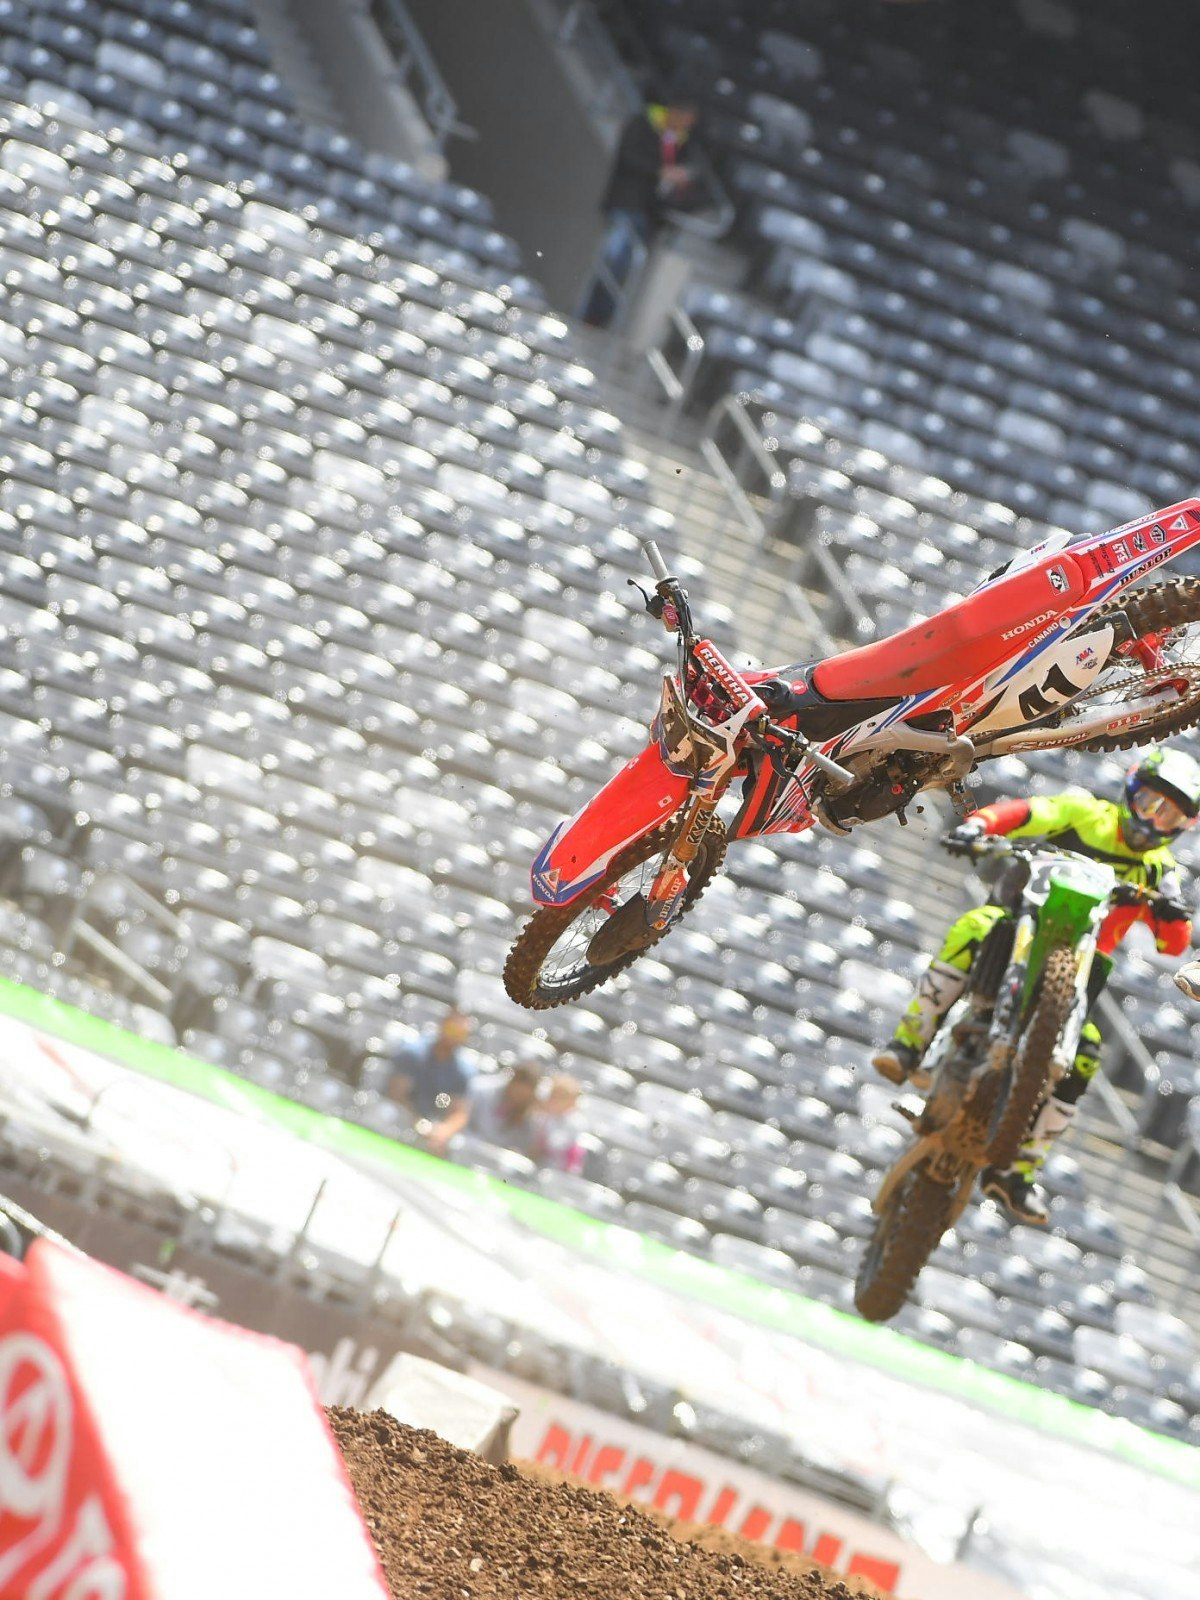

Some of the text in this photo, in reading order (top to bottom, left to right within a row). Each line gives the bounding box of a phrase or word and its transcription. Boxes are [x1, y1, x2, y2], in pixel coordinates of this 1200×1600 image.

[1119, 547, 1172, 586] DUNLOP
[1001, 609, 1059, 641] HONDA
[1027, 622, 1060, 649] CANARD
[700, 647, 750, 704] RENTHA
[1018, 662, 1083, 721] 41
[532, 874, 555, 903] HONDA
[659, 877, 683, 919] DUNLOP
